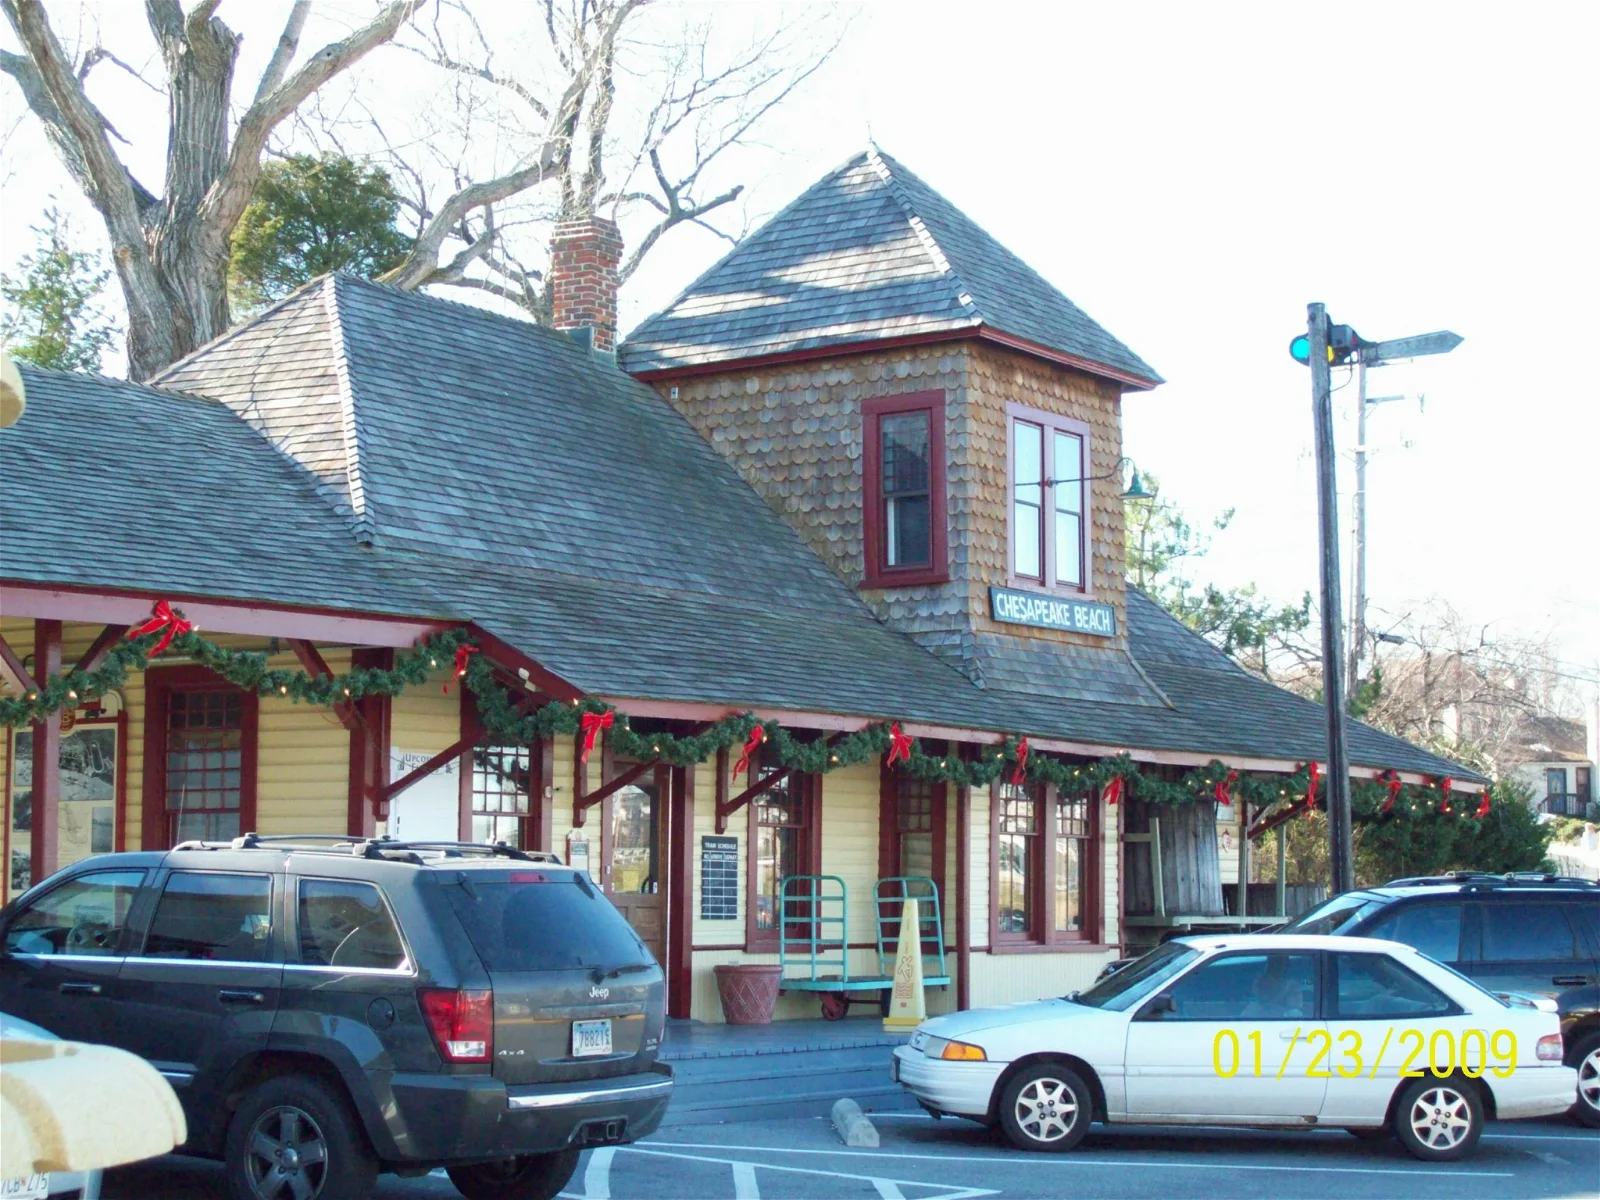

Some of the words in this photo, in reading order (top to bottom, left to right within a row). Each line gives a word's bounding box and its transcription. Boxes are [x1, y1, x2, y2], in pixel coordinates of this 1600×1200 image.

[996, 593, 1070, 625] CHESAPEAKE
[1074, 605, 1111, 631] BEACH
[589, 986, 610, 1000] Jeep
